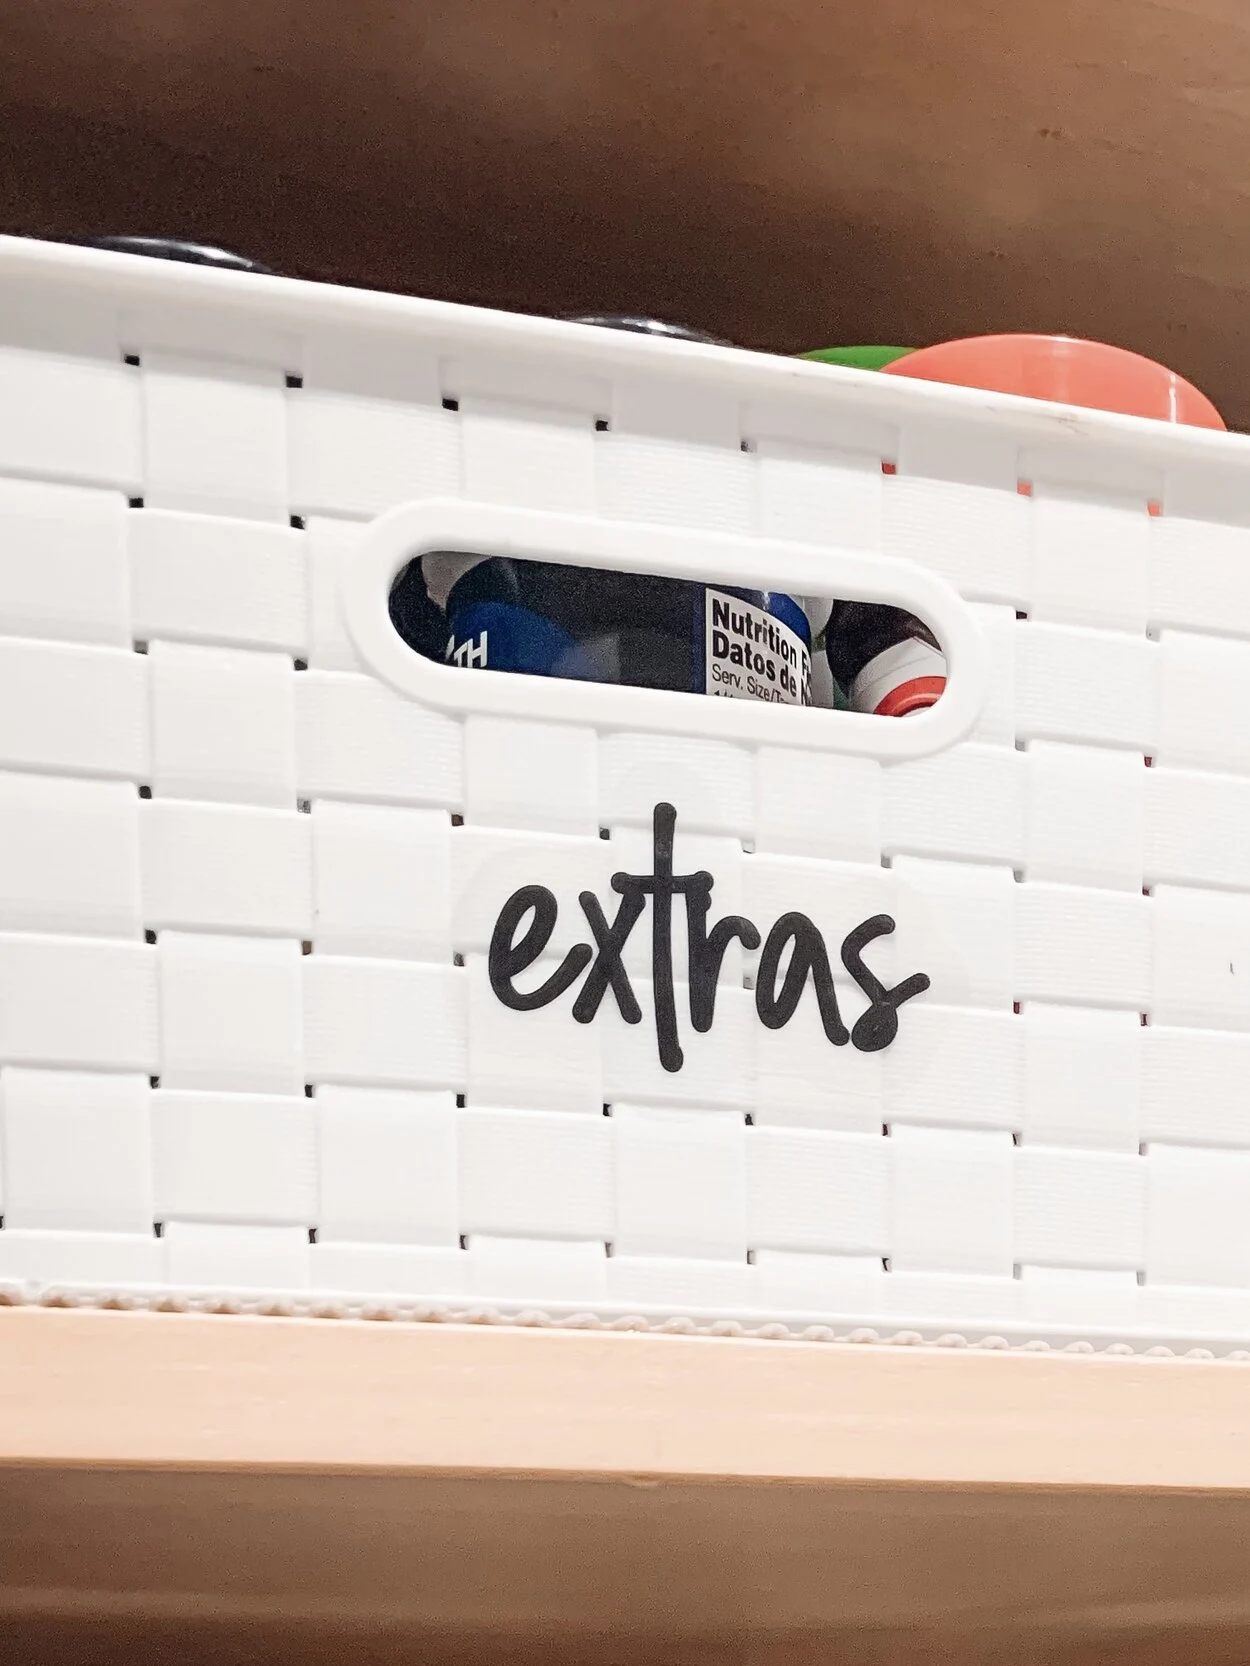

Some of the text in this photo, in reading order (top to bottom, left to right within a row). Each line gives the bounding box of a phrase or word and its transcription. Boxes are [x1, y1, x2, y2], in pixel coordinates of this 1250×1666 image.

[712, 598, 797, 669] Nutrition
[712, 629, 776, 682] Datos
[780, 664, 797, 697] de
[712, 663, 744, 690] Serv.
[488, 802, 931, 1072] extras
